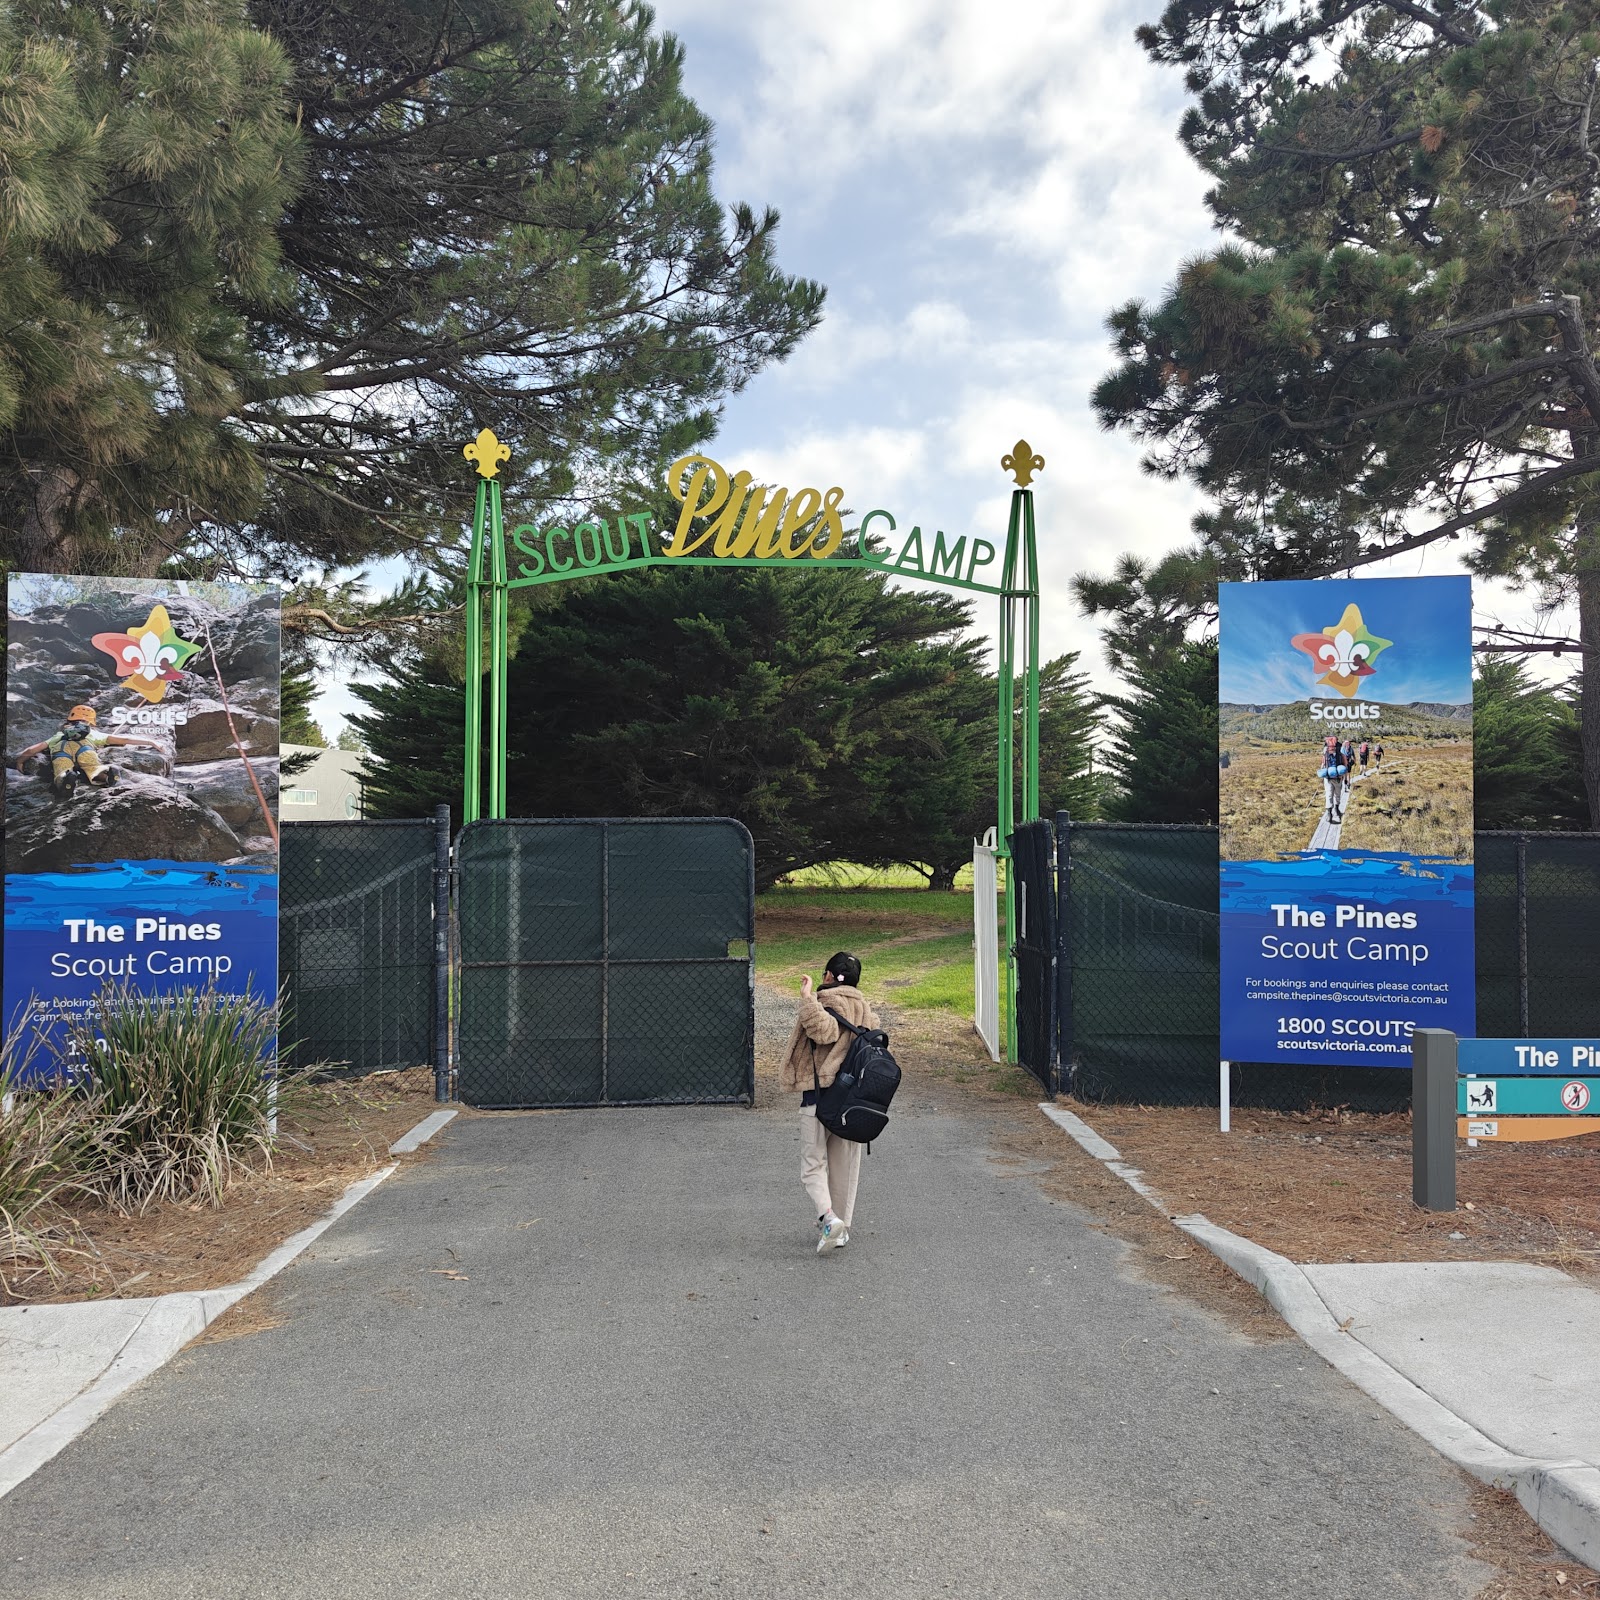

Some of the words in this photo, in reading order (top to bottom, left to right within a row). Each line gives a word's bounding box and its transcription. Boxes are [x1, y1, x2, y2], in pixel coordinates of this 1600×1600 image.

[513, 511, 652, 577] SCOUT
[661, 455, 844, 559] Pines
[858, 509, 995, 581] CAMP
[111, 706, 188, 726] Scouts
[1309, 702, 1381, 720] Scouts
[1271, 904, 1326, 928] The
[1336, 904, 1418, 929] Pines
[63, 919, 125, 943] The
[135, 917, 222, 941] Pines
[1261, 935, 1339, 960] Scout
[1347, 937, 1429, 966] Camp
[50, 953, 138, 977] Scout
[146, 951, 232, 977] Camp
[1245, 978, 1262, 987] For
[1263, 978, 1307, 989] bookings
[1309, 980, 1328, 989] and
[1330, 981, 1374, 990] enquiries
[1376, 981, 1409, 992] please
[1411, 982, 1449, 993] contact
[32, 999, 50, 1008] For
[128, 994, 174, 1006] euiies
[1246, 989, 1448, 1004] campsite.thepines@scoutsvictoria.com.au
[1277, 1018, 1326, 1034] 1800
[1331, 1019, 1416, 1037] SCOUTS
[1514, 1046, 1559, 1067] The
